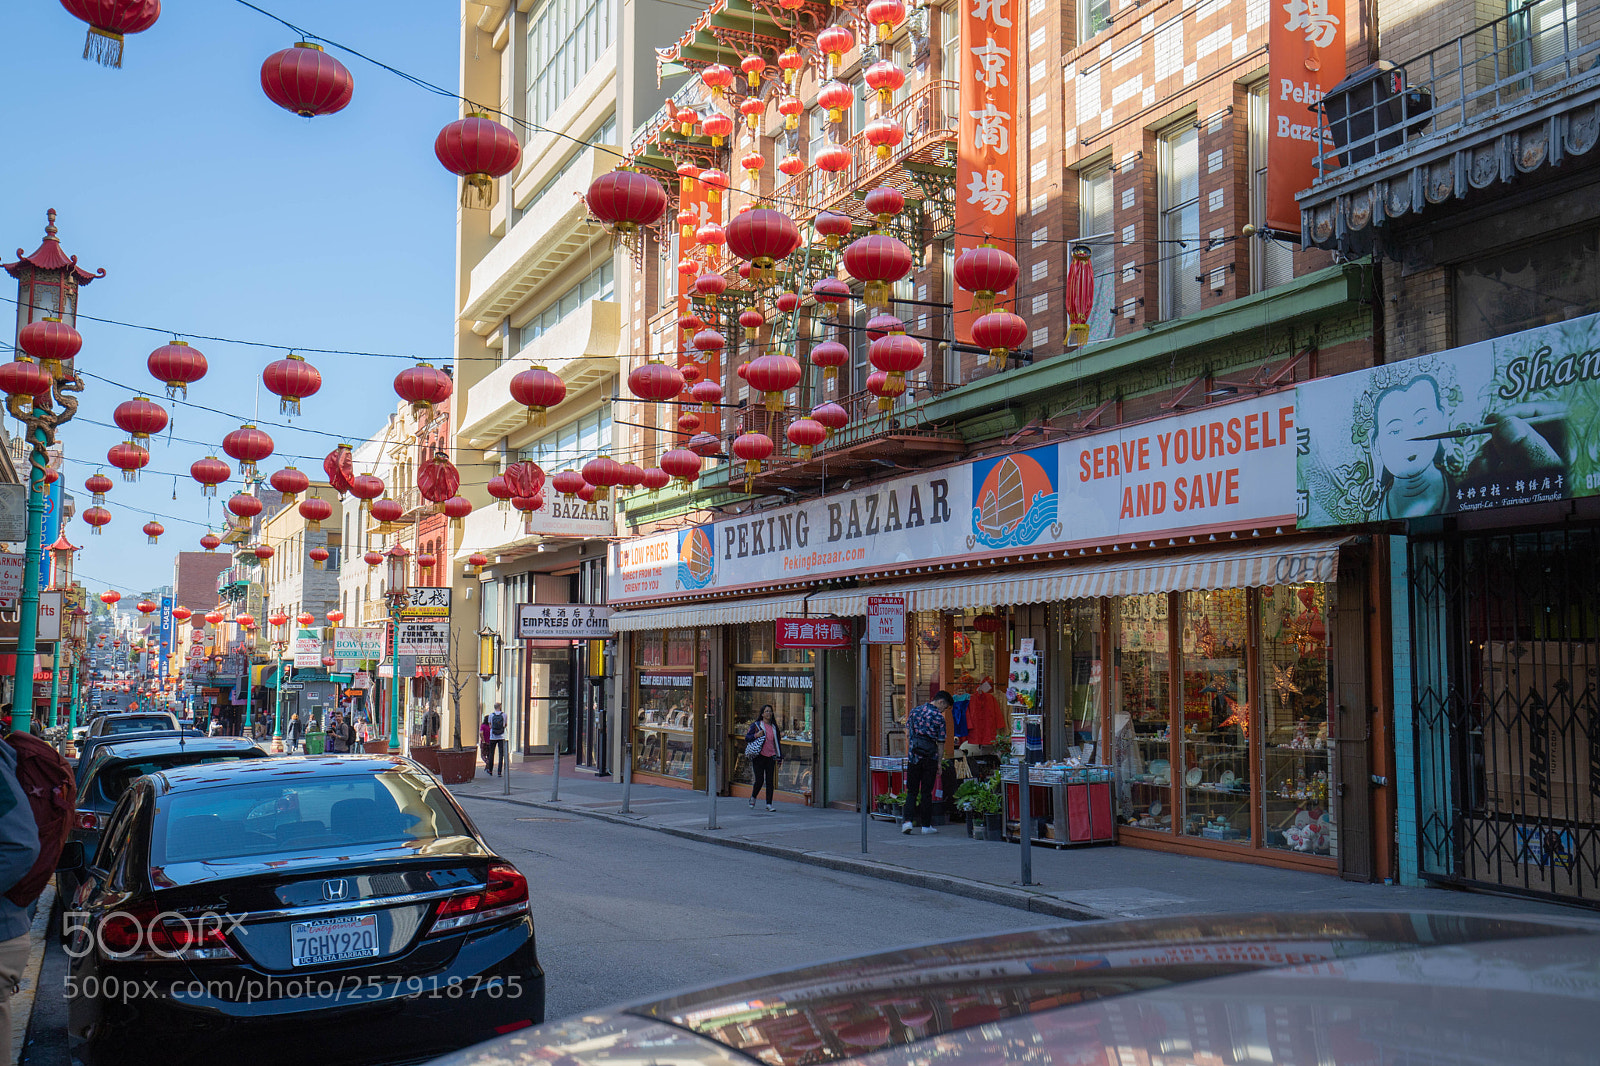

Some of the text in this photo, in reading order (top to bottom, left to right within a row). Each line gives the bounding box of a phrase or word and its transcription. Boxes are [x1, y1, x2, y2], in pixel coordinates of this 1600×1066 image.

[1280, 79, 1328, 106] Peki
[1277, 115, 1335, 145] Baza
[1080, 406, 1294, 482] SERVE YOURSELF
[1120, 468, 1240, 519] AND SAVE
[552, 502, 610, 521] BAZAAR
[724, 478, 952, 560] PEKING BAZAAR
[616, 541, 669, 568] LOW LOW PRICES
[783, 547, 866, 571] PekingBazaar.com
[622, 566, 662, 581] DIRECT FROM THE
[624, 580, 659, 593] ORIENT TO YOU
[868, 604, 903, 616] NO STOPPING
[521, 617, 609, 627] EMPRESS OF CHIN
[879, 617, 893, 626] ANY
[784, 623, 844, 640] 清倉特價
[878, 626, 895, 635] TIME
[773, 676, 779, 687] TO
[787, 676, 799, 688] YOUR
[309, 921, 362, 934] California
[296, 930, 373, 957] 7GHY920
[312, 954, 337, 963] SANTA
[338, 949, 372, 959] BARBARA
